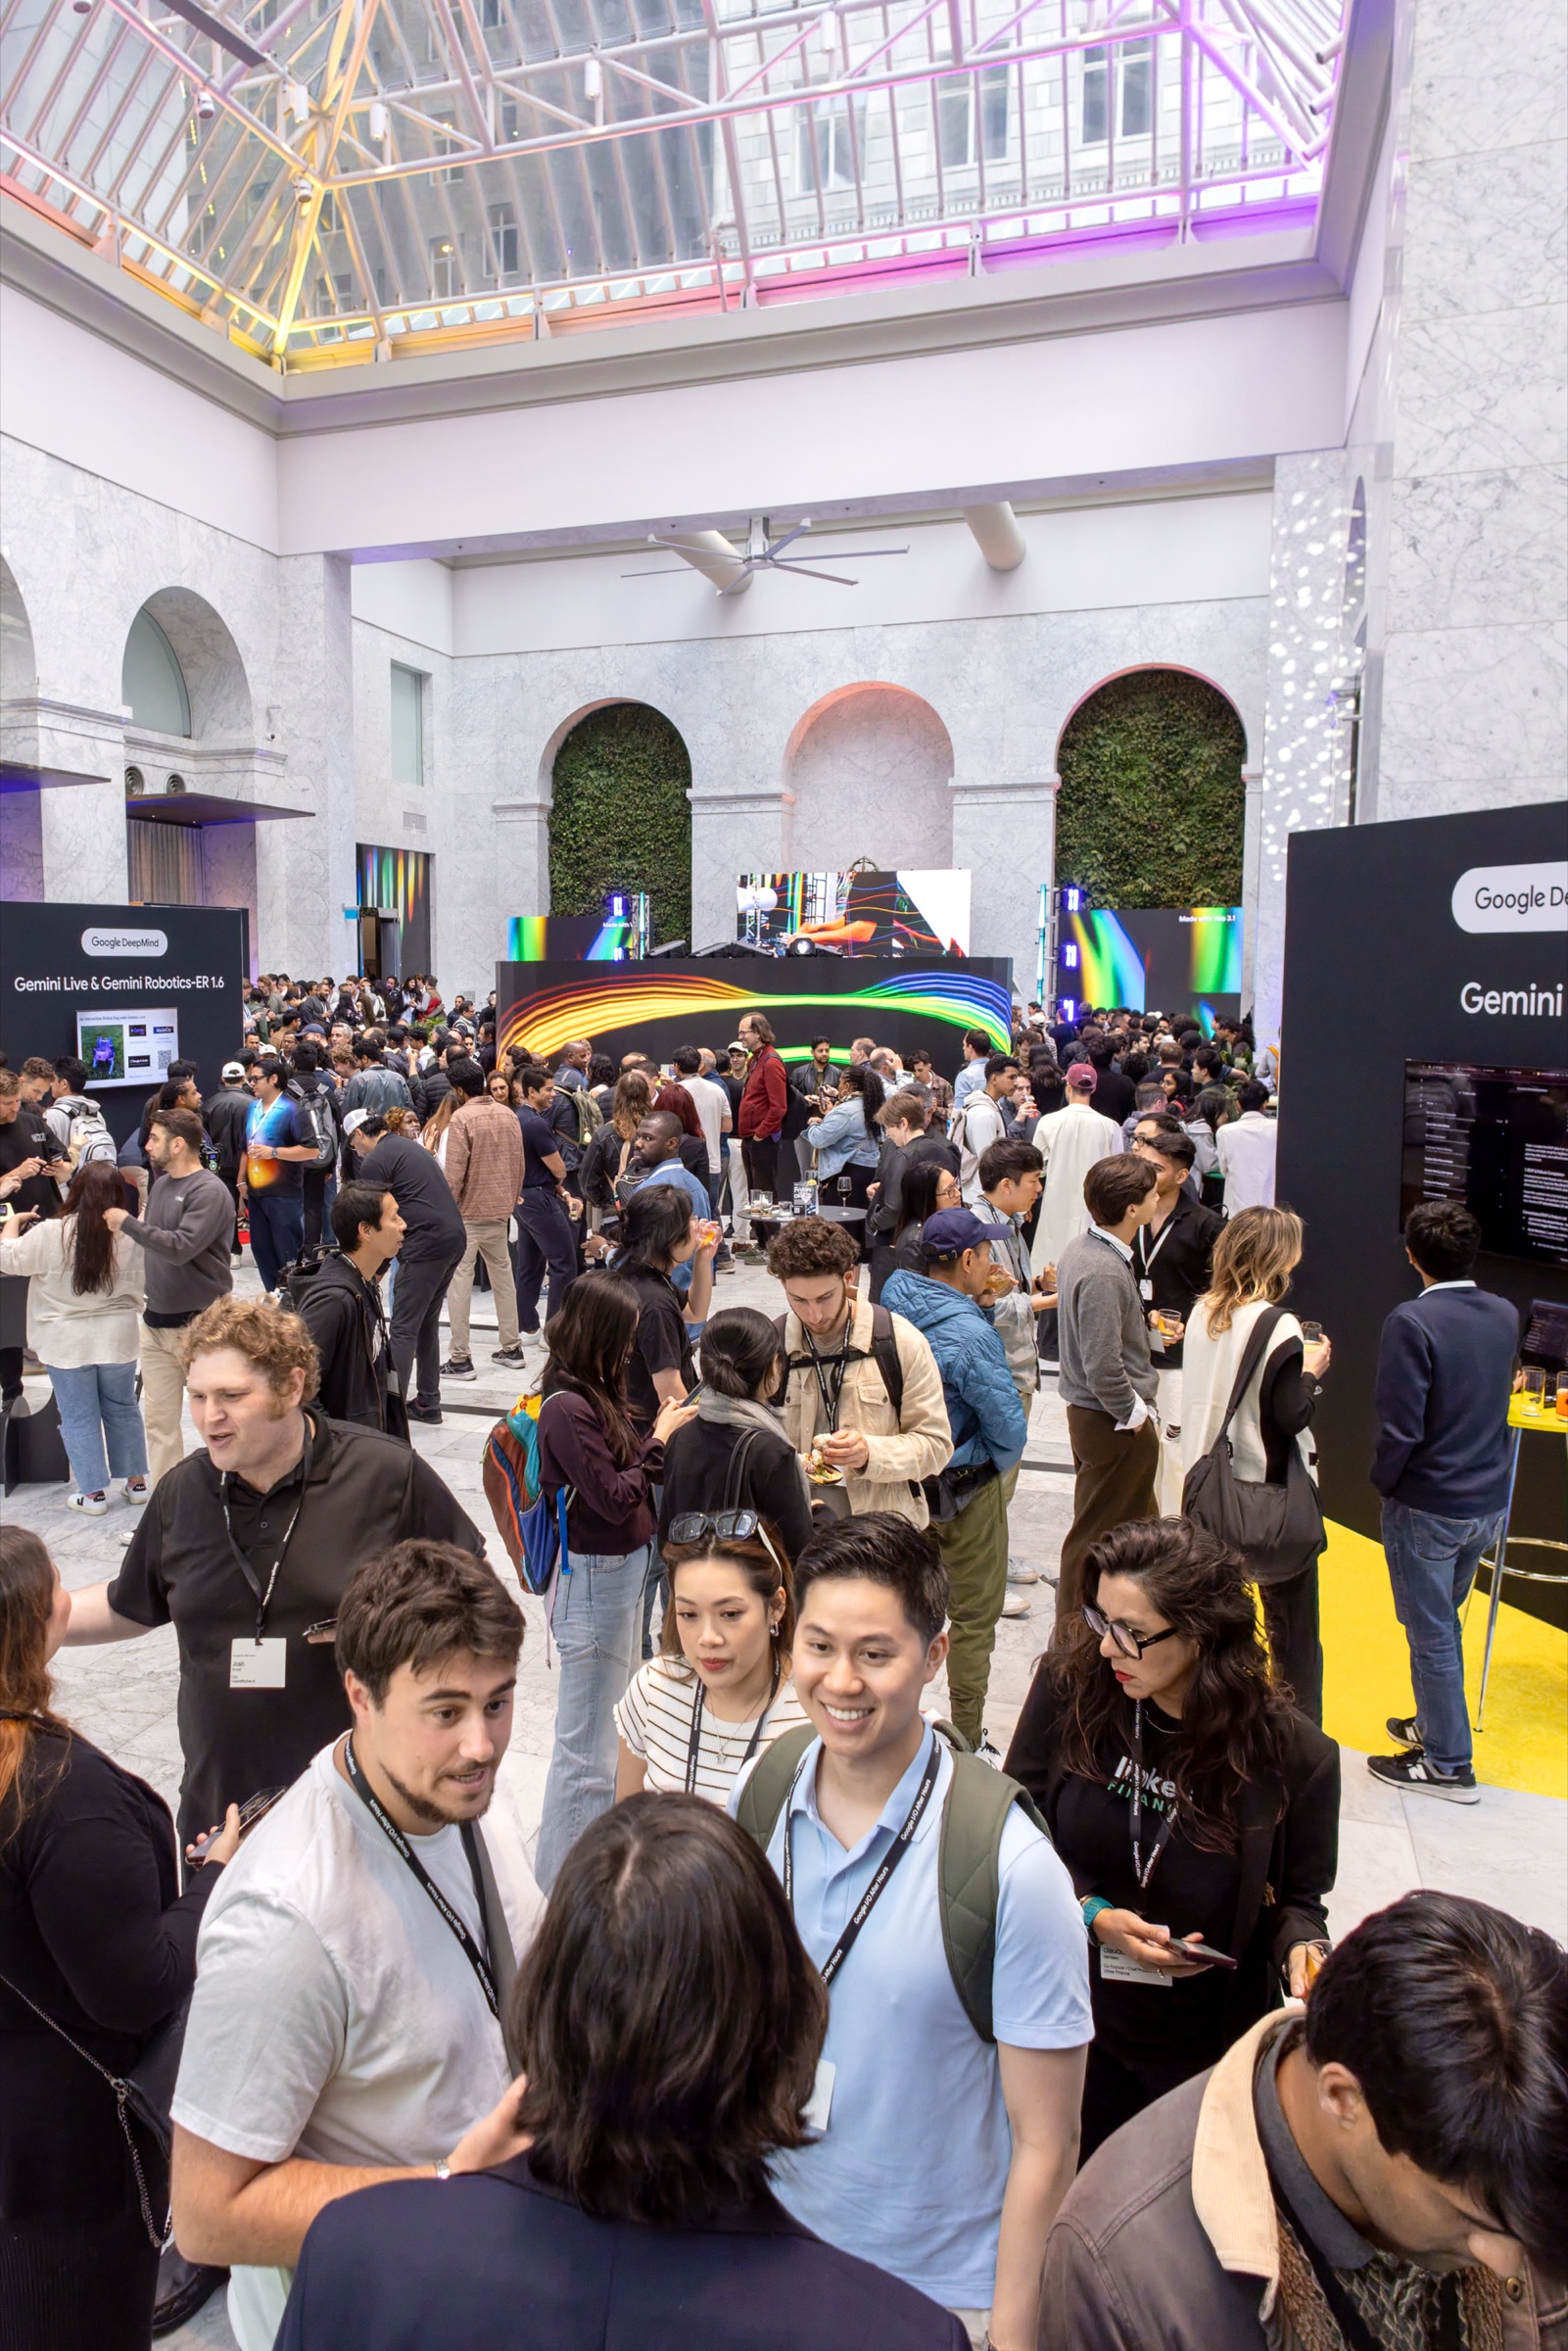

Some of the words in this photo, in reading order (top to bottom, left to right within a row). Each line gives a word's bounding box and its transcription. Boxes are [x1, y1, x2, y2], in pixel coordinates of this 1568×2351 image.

[1475, 885, 1545, 914] Google
[92, 936, 121, 949] Google
[122, 937, 159, 949] DeepMind
[14, 976, 61, 991] Gemini
[64, 976, 88, 991] Live
[91, 976, 99, 990] &
[101, 976, 142, 990] Gemini
[145, 975, 209, 989] Robotics-ER
[211, 976, 224, 989] 1.6
[1461, 982, 1563, 1017] Gemini
[370, 1799, 382, 1819] Hours
[901, 1819, 914, 1840] Google
[915, 1795, 925, 1811] After
[921, 1779, 931, 1796] Hours
[380, 1816, 391, 1830] After
[389, 1828, 397, 1840] I/O
[396, 1839, 410, 1858] Google
[427, 1882, 439, 1901] Hours
[854, 1903, 866, 1925] Google
[864, 1895, 872, 1906] I/O
[869, 1882, 880, 1897] After
[877, 1866, 889, 1884] Hours
[438, 1899, 447, 1913] After
[446, 1910, 454, 1922] I/O
[453, 1919, 466, 1940] Google
[824, 1964, 833, 1978] After
[831, 1949, 842, 1966] Hours
